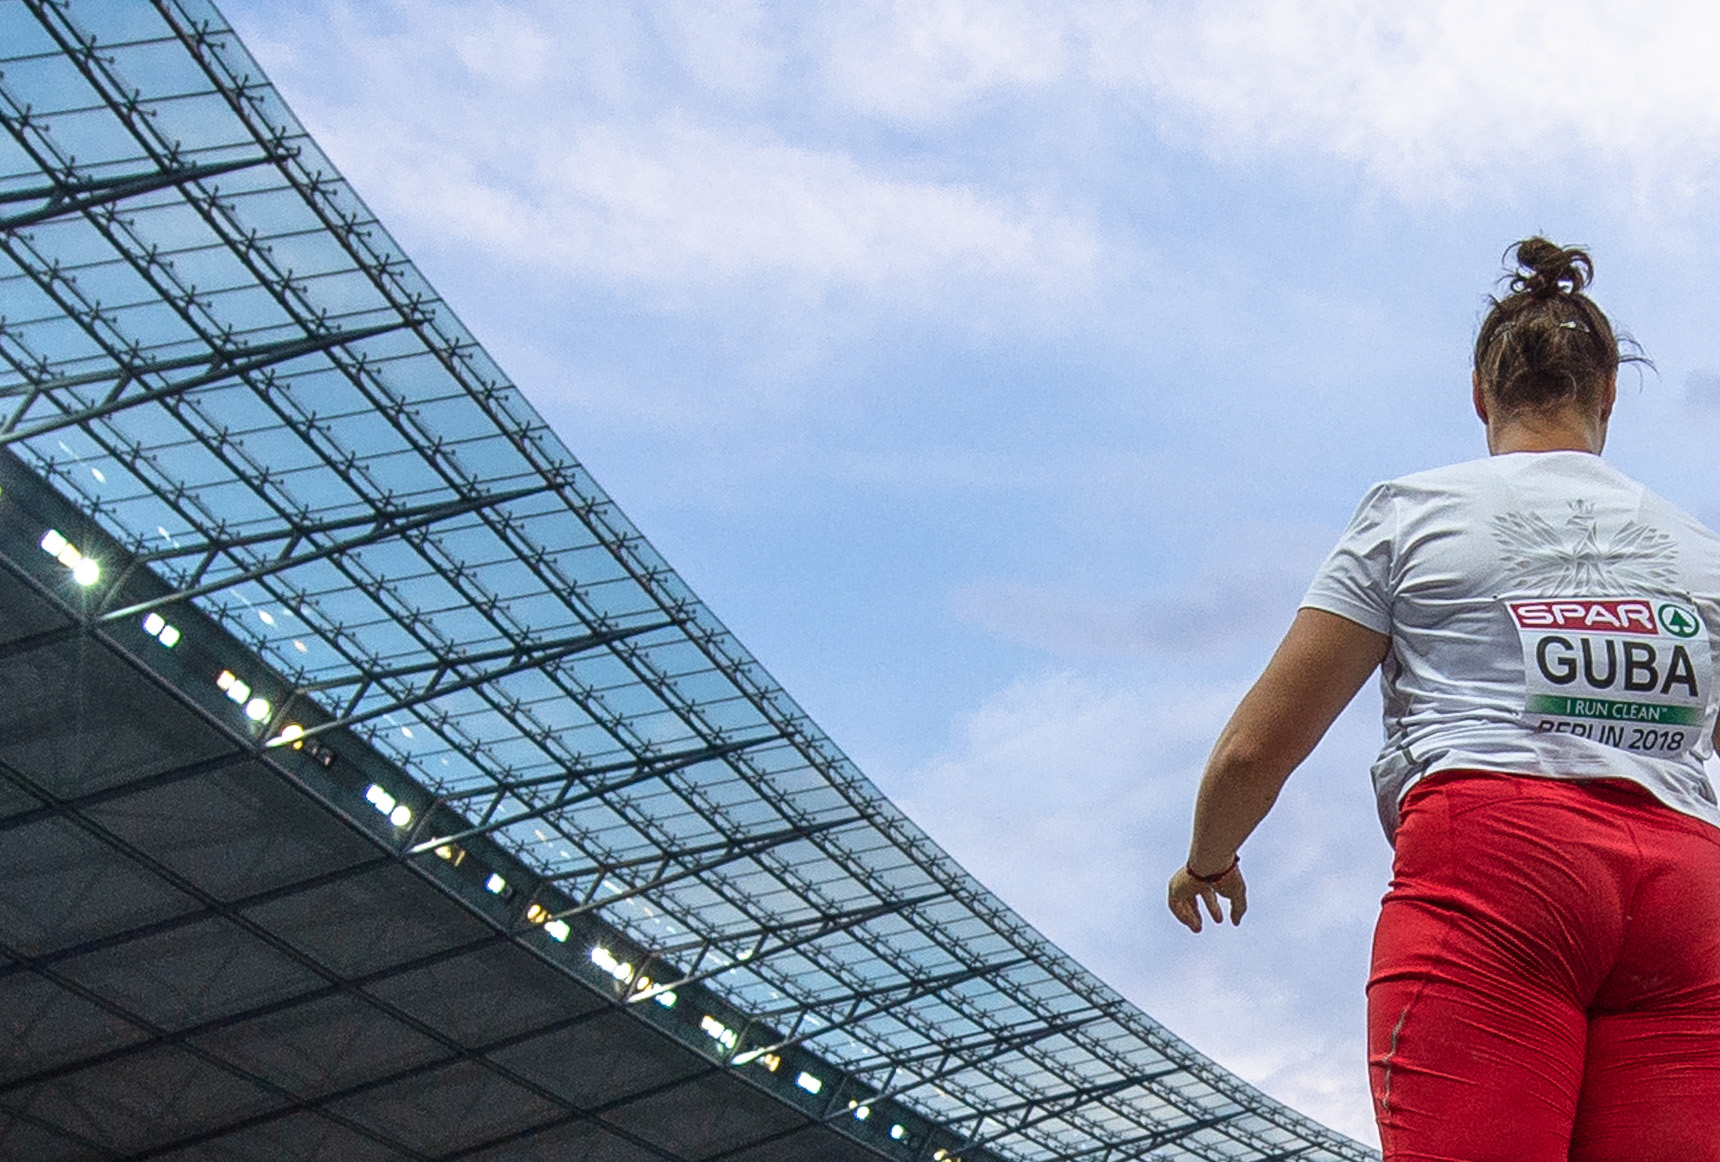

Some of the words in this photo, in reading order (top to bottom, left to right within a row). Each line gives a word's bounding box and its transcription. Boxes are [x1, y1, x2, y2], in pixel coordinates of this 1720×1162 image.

[1517, 602, 1654, 630] SPAR
[1536, 635, 1698, 697] GUBA
[1566, 700, 1571, 713] I
[1575, 701, 1608, 716] RUN
[1628, 728, 1685, 751] 2018
